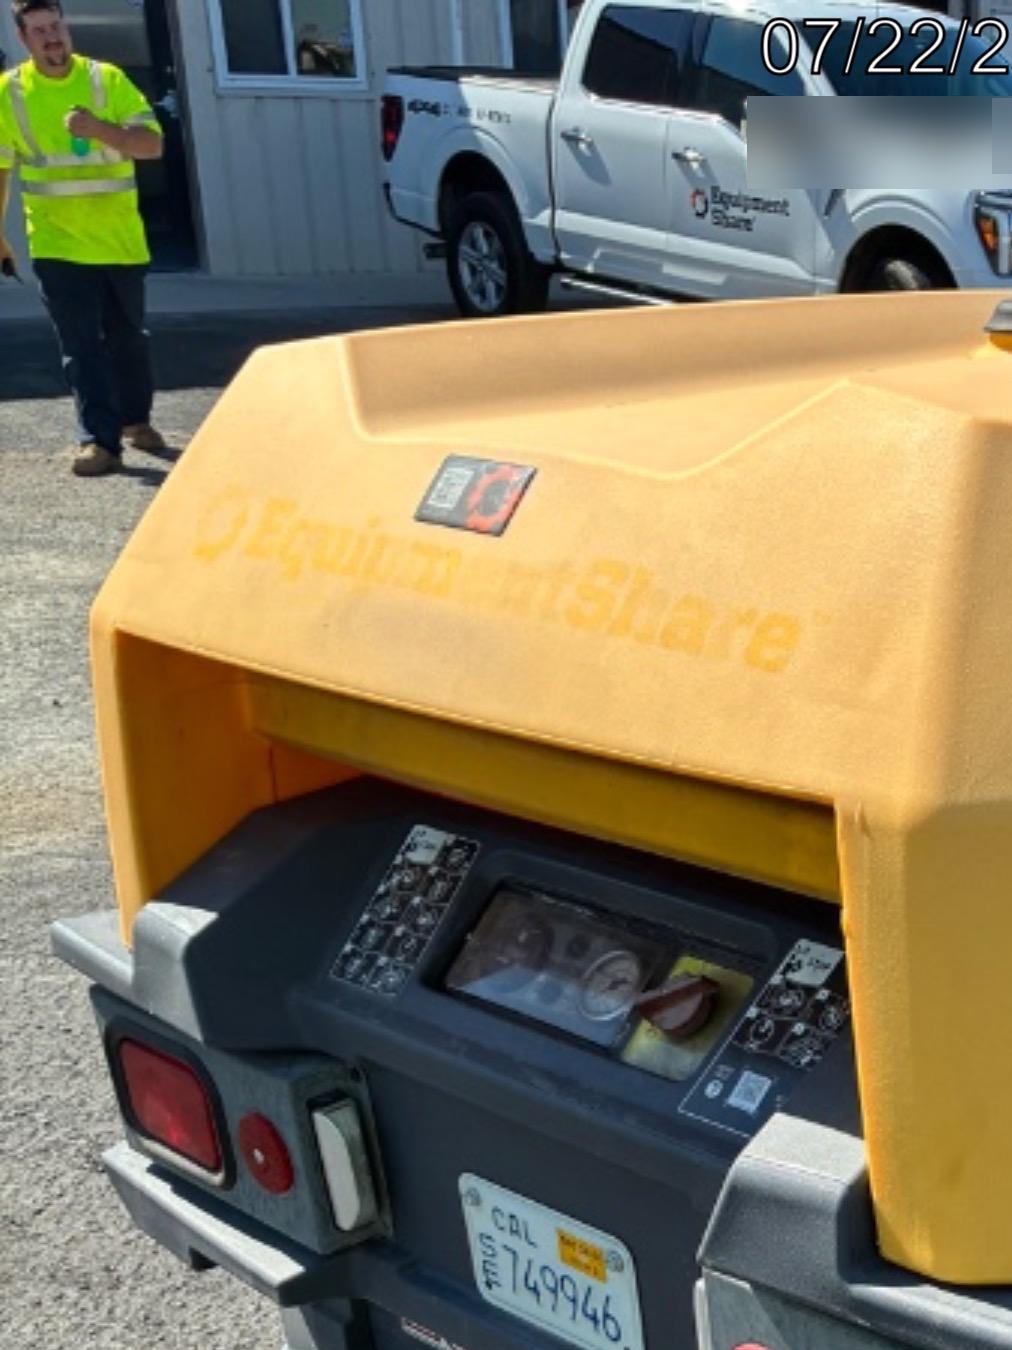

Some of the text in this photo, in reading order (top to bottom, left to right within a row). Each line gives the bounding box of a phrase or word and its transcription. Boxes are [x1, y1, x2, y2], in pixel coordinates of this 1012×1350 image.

[711, 186, 789, 216] Equipment
[711, 209, 754, 232] Share
[244, 496, 802, 675] EquipmntShare
[491, 1207, 538, 1249] CAL
[503, 1245, 621, 1342] 749946
